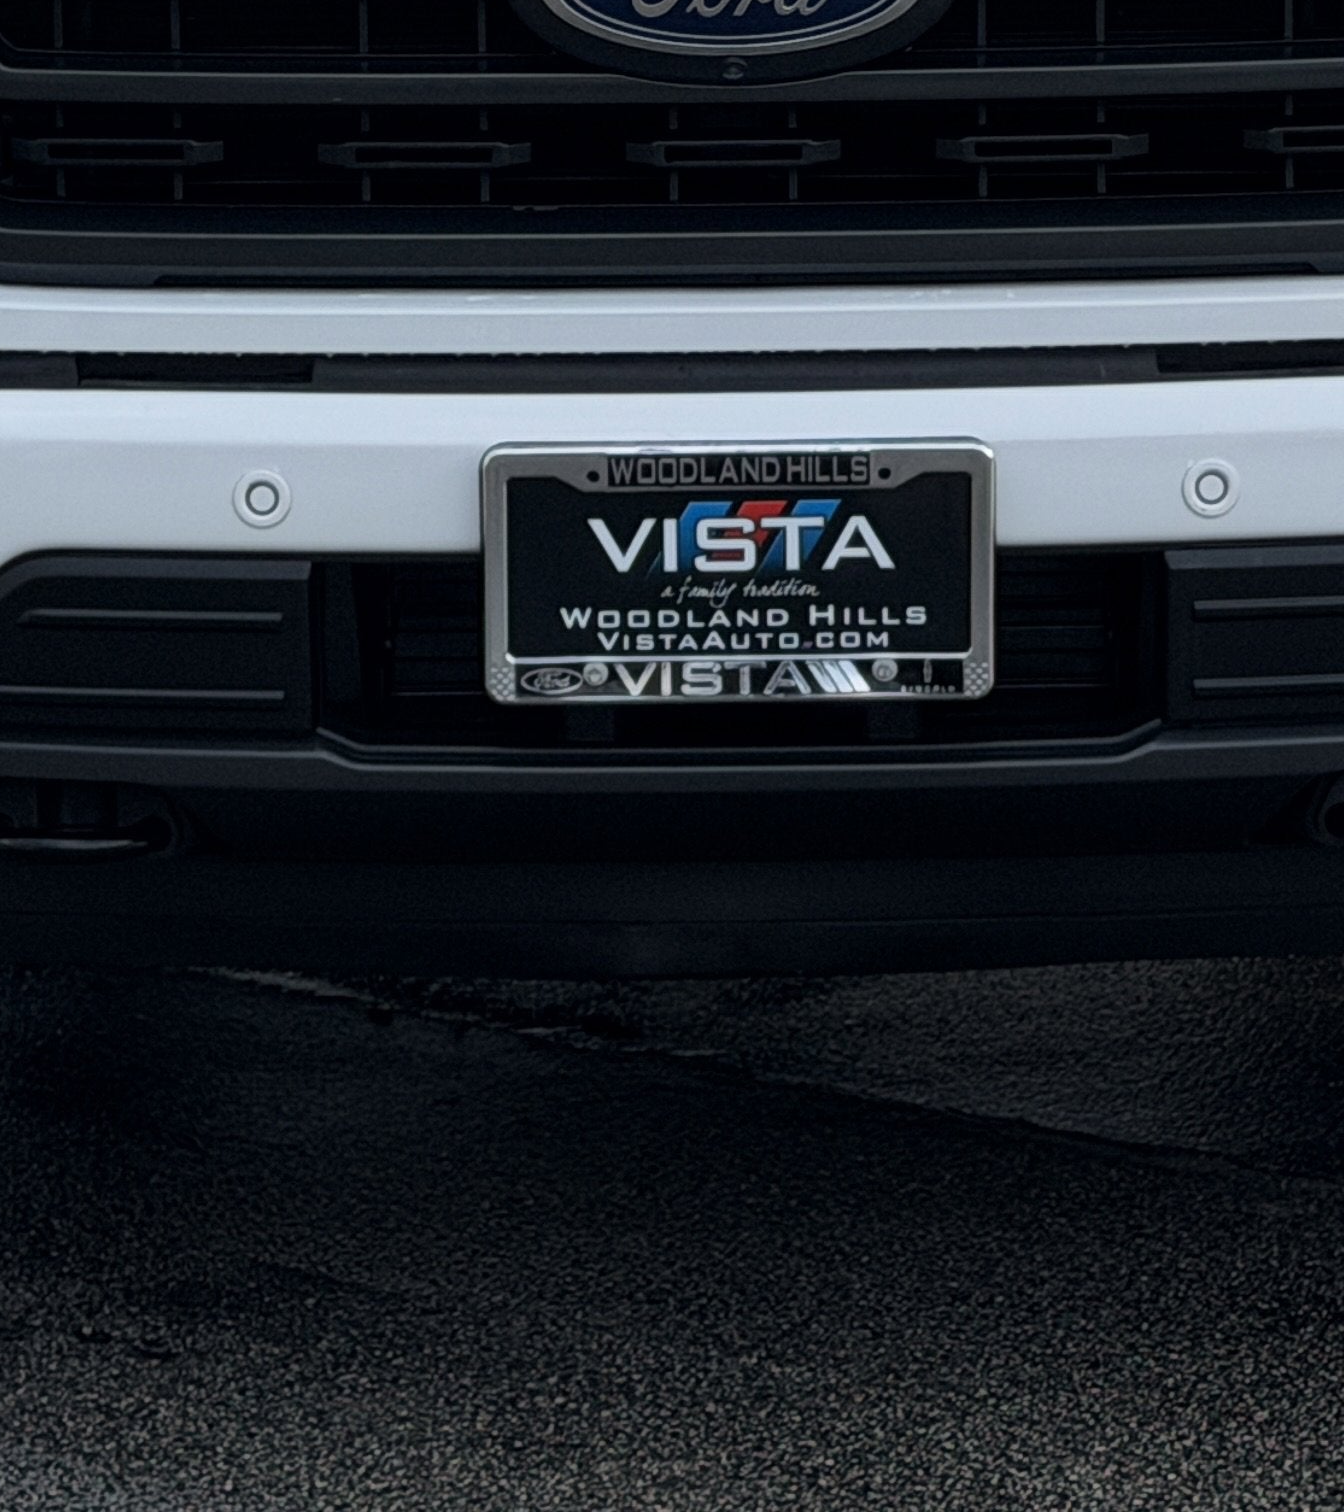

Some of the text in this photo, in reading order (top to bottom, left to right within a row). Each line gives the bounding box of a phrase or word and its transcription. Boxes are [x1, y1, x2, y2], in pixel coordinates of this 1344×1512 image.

[609, 454, 869, 485] WOODLAND HILLS
[587, 515, 896, 573] VISTA
[676, 575, 737, 608] family
[742, 577, 821, 598] tradition
[613, 660, 812, 696] VISTA
